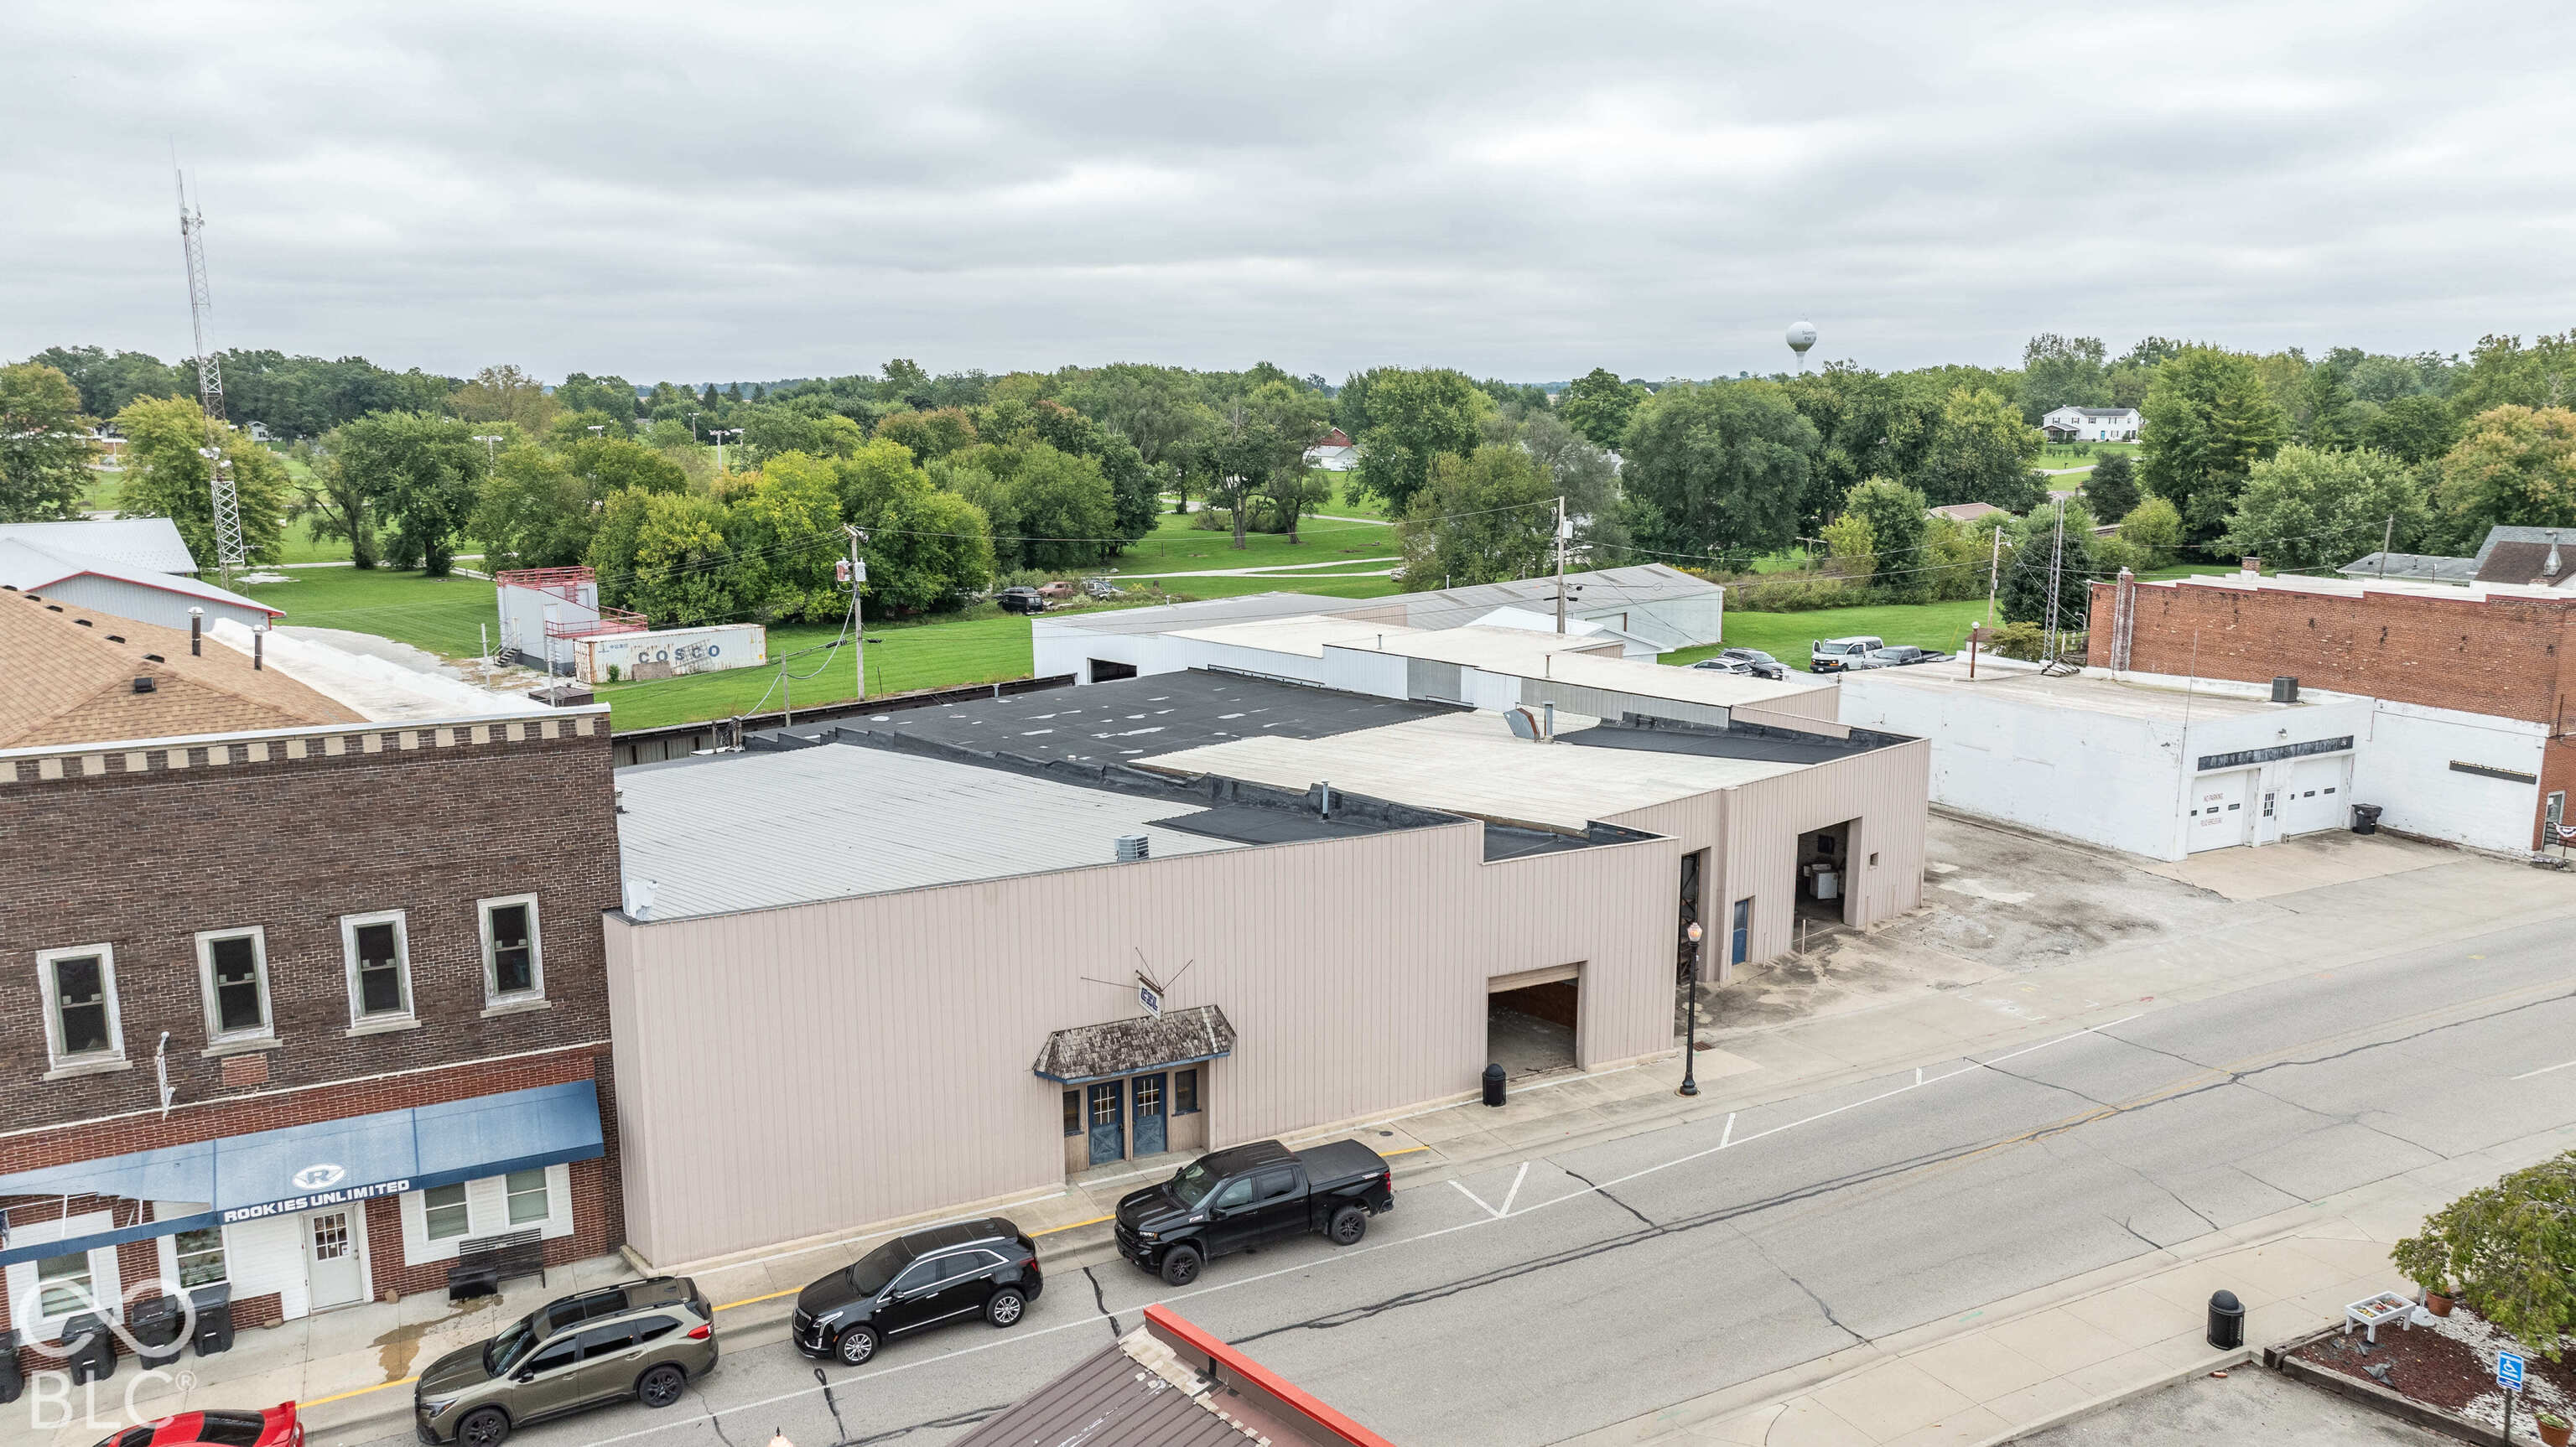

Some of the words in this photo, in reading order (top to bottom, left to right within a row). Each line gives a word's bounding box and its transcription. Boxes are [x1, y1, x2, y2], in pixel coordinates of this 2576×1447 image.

[638, 645, 720, 664] COSCO
[224, 1197, 309, 1222] ROOKIES
[310, 1180, 410, 1206] UNLIMITED
